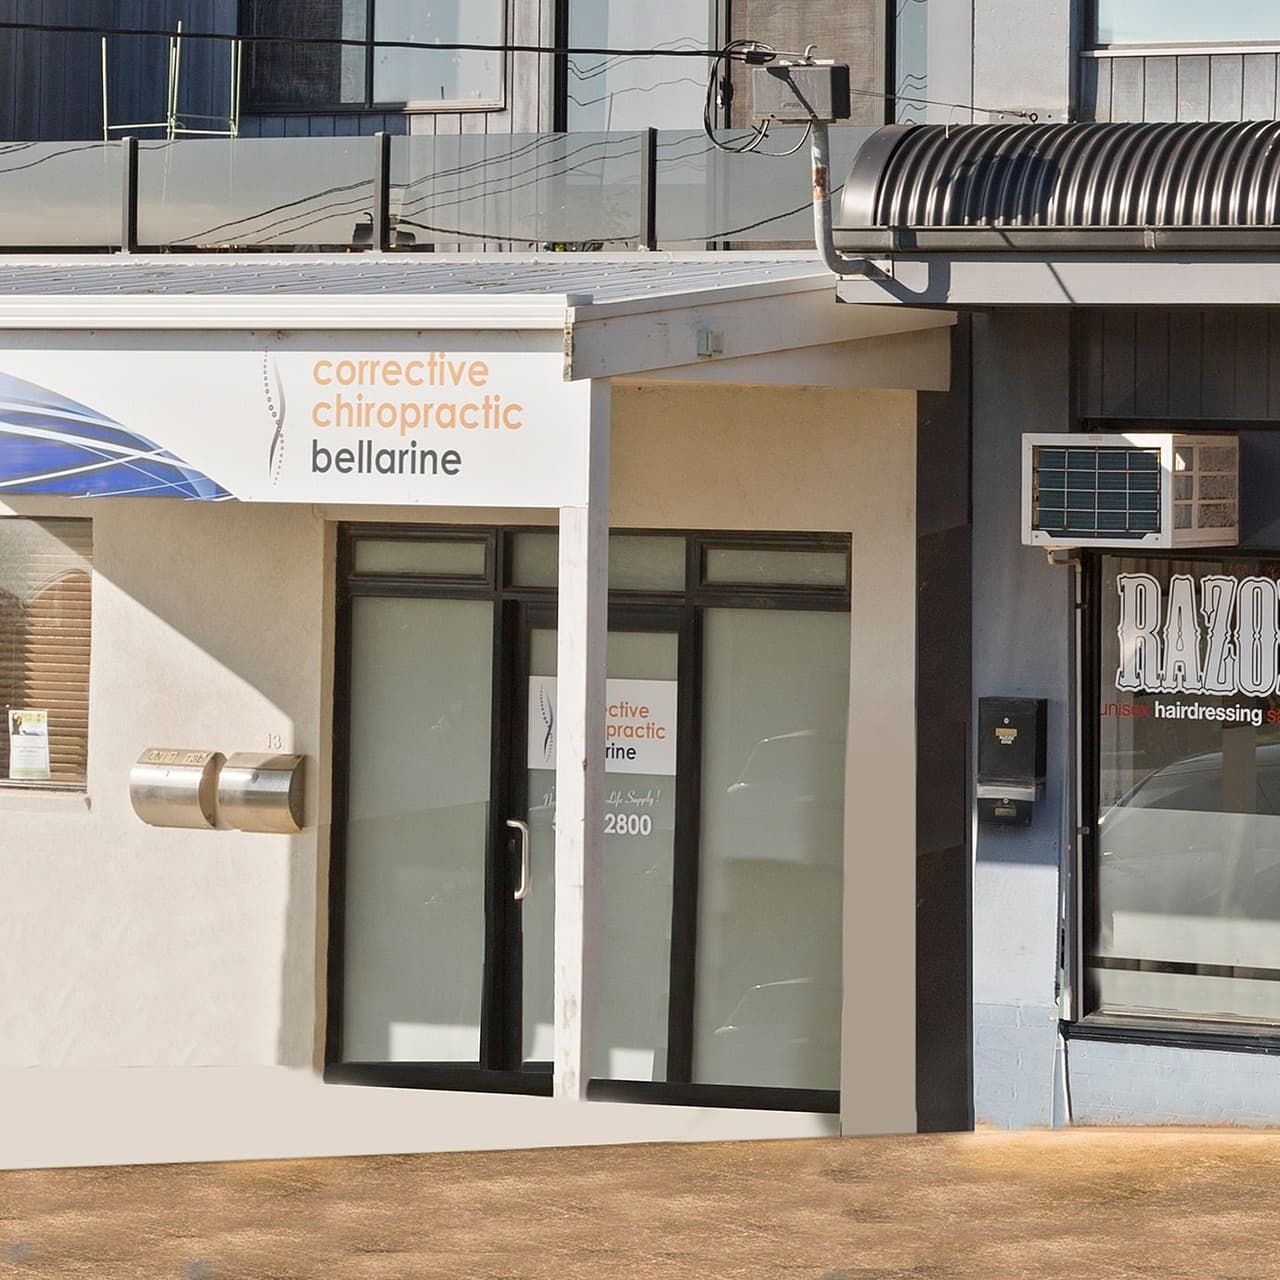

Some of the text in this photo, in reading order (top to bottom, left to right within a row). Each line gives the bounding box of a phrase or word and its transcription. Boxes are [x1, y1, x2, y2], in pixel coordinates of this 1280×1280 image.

[312, 351, 490, 387] corrective
[311, 393, 525, 437] chiropractic
[311, 439, 463, 476] bellarine
[1154, 701, 1263, 727] hairdressing
[267, 733, 282, 750] 13
[606, 723, 666, 740] practic
[603, 813, 652, 836] 2800
